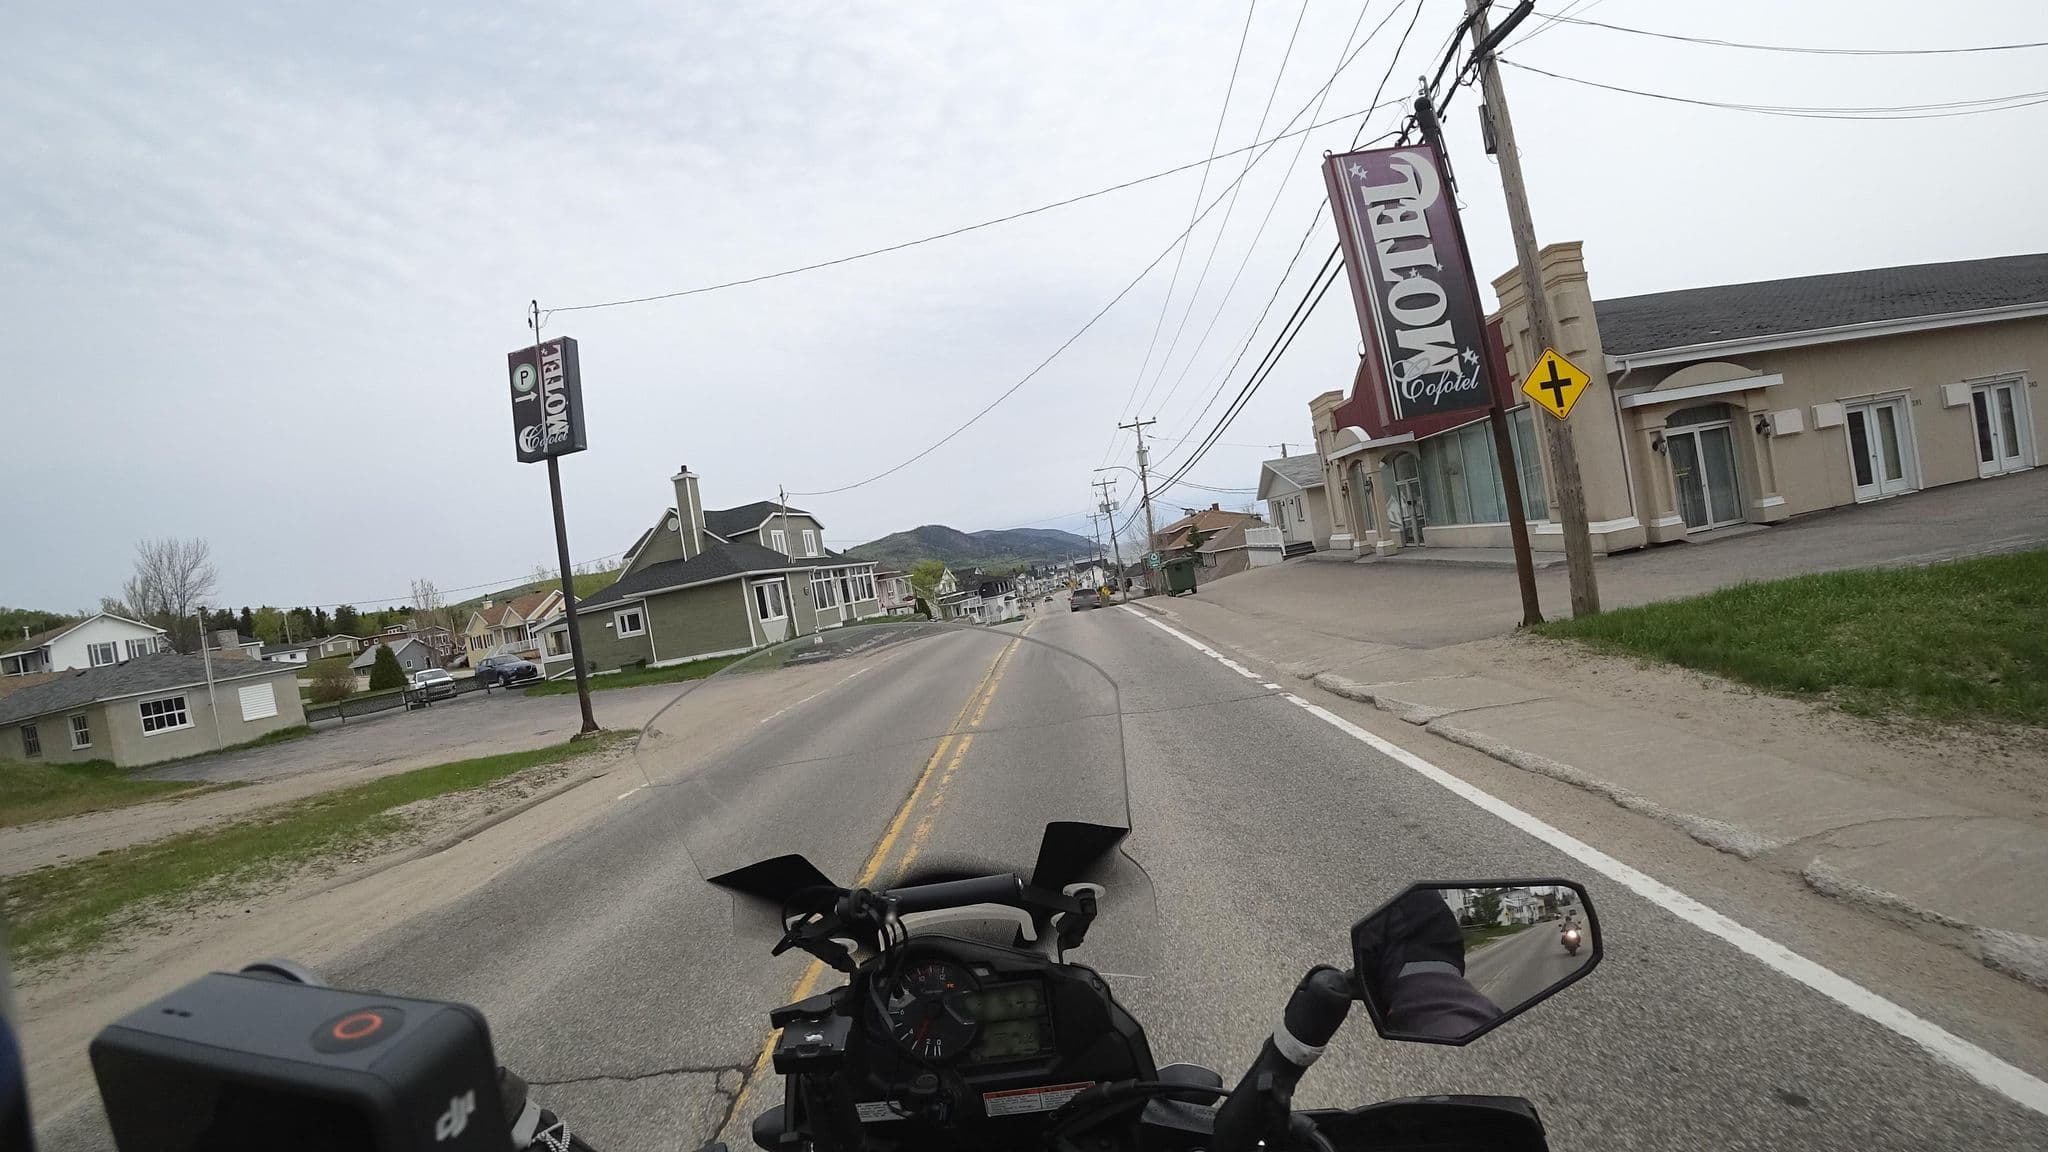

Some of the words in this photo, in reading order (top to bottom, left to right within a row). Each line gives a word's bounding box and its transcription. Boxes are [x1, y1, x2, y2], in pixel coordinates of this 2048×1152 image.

[1361, 162, 1462, 376] MOTEL
[520, 370, 529, 385] P
[542, 344, 569, 434] MOTEL
[1392, 359, 1480, 405] Cofotel
